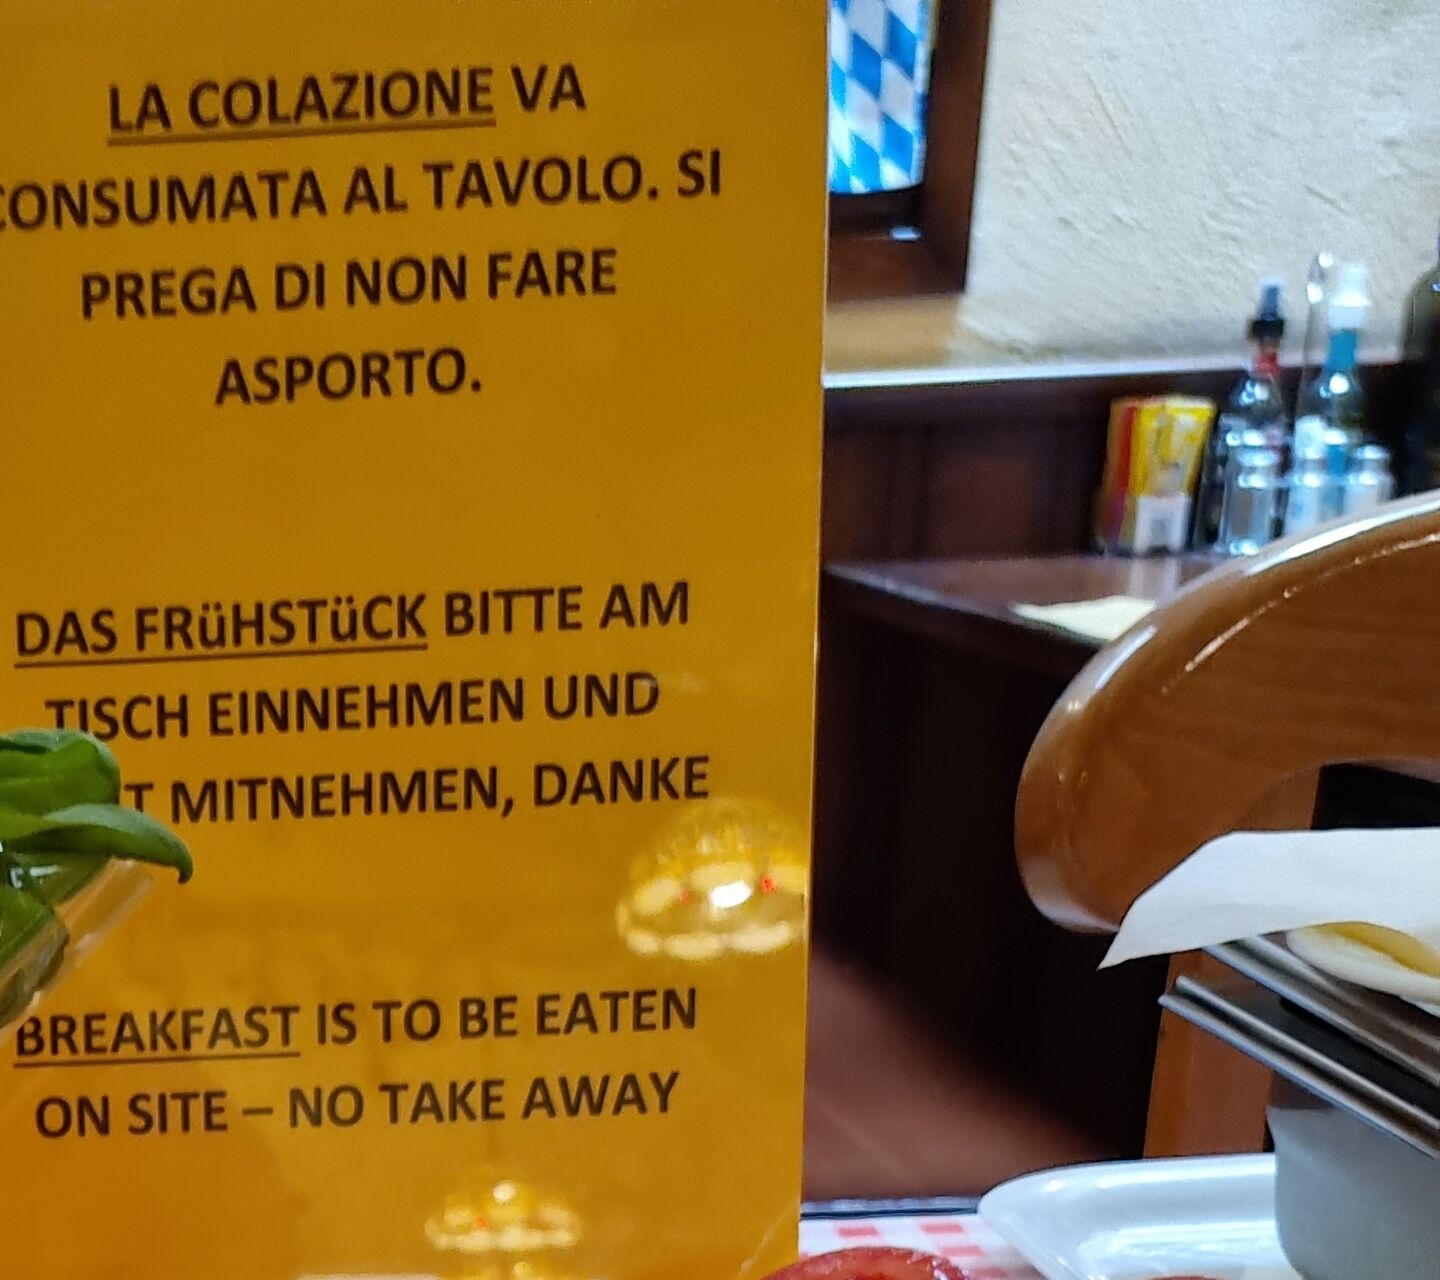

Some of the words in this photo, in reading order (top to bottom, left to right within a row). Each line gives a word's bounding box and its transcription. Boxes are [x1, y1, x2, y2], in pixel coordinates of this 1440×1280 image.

[109, 83, 172, 132] LA
[188, 67, 494, 130] COLAZIONE
[511, 64, 586, 112] VA
[343, 165, 408, 215] AL
[422, 154, 658, 210] TAVOLO.
[677, 149, 721, 198] SI
[82, 267, 257, 319] PREGA
[275, 262, 325, 310] DI
[346, 255, 467, 307] NON
[488, 248, 617, 300] FARE
[215, 347, 481, 405] ASPORTO.
[16, 609, 118, 657] DAS
[445, 585, 583, 637] BITTE
[599, 581, 689, 629] AM
[44, 694, 189, 741] TISCH
[208, 677, 524, 736] EINNEHMEN
[544, 672, 660, 720] UND
[171, 765, 514, 824] MITNEHMEN,
[533, 755, 709, 807] DANKE
[16, 1003, 300, 1056] BREAKFAST
[317, 1001, 357, 1045] IS
[372, 998, 441, 1043] TO
[459, 995, 518, 1039] BE
[536, 987, 697, 1036] EATEN
[35, 1095, 110, 1139] ON
[128, 1091, 228, 1135] SITE
[289, 1084, 364, 1128] NO
[378, 1079, 505, 1124] TAKE
[522, 1071, 680, 1119] AWAY
